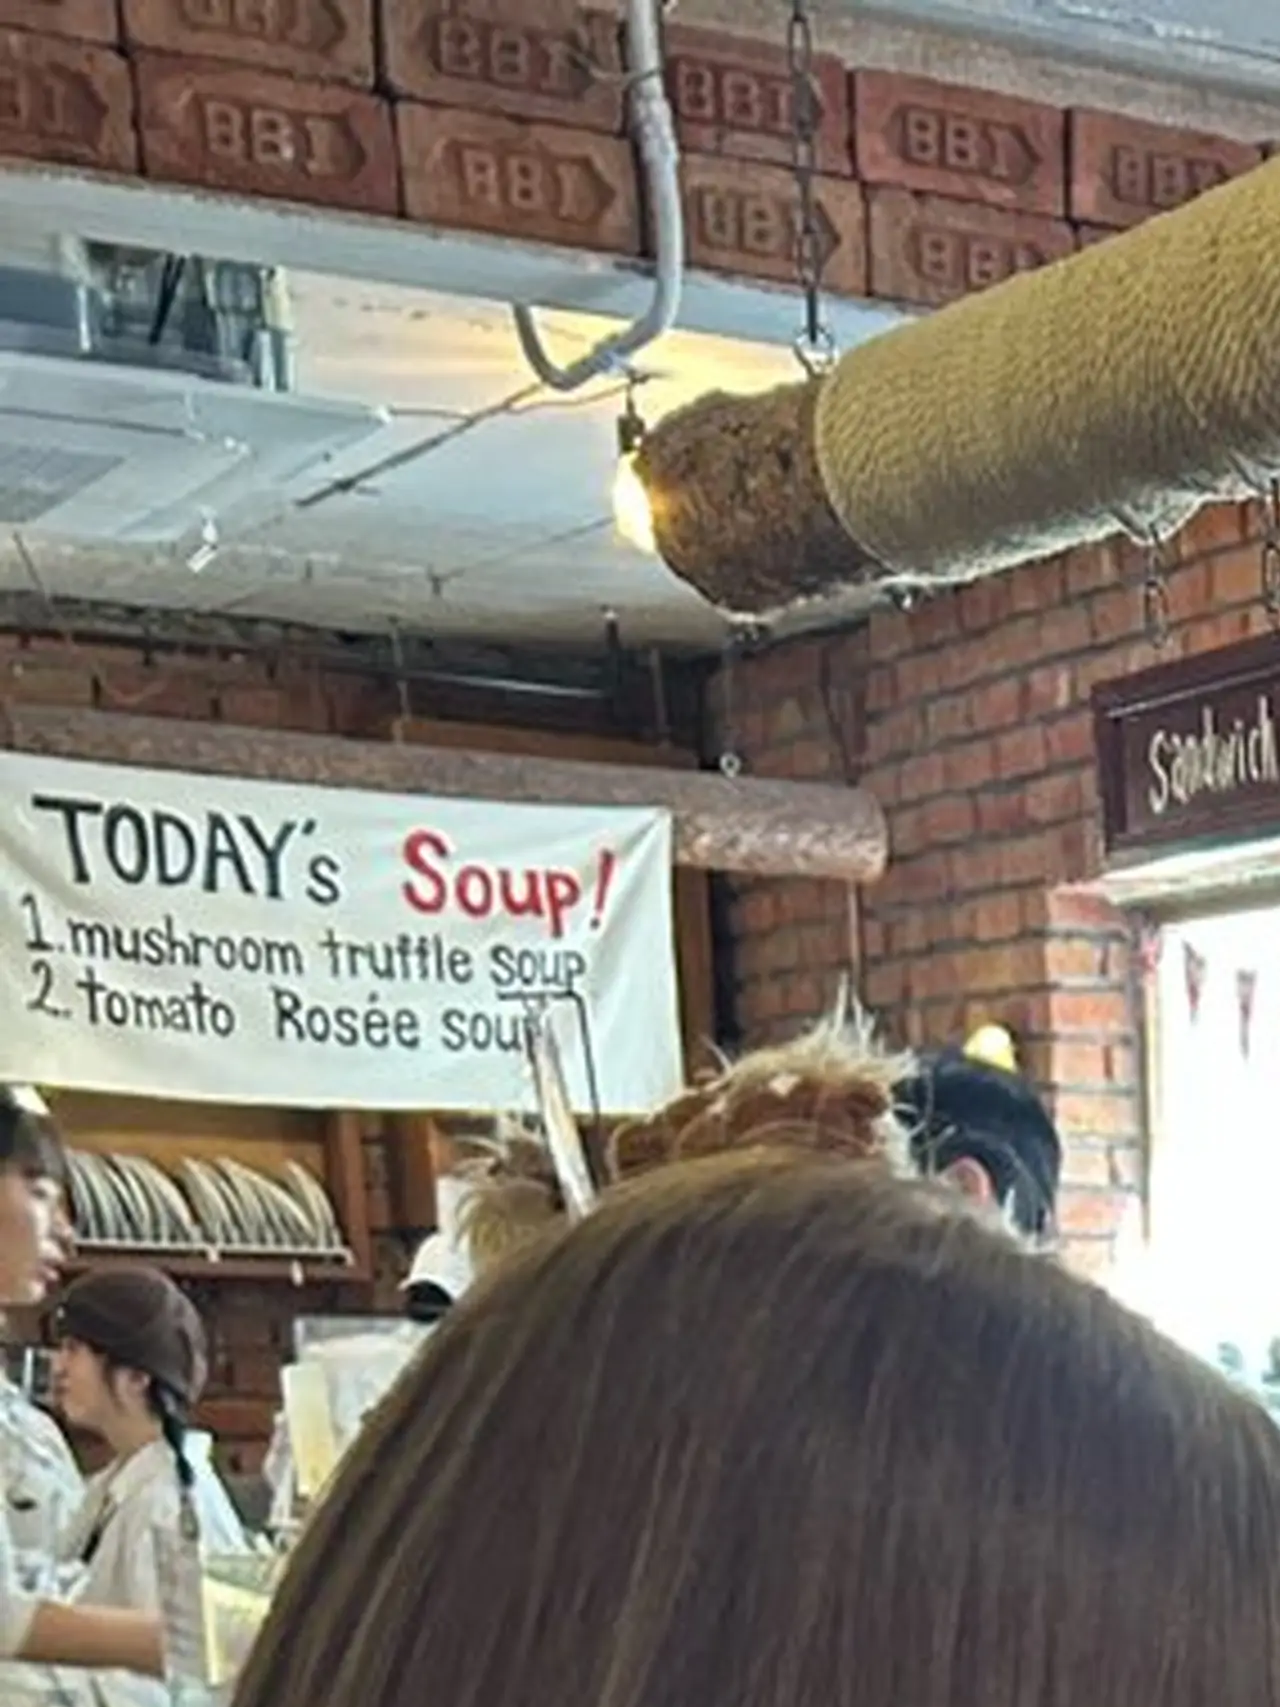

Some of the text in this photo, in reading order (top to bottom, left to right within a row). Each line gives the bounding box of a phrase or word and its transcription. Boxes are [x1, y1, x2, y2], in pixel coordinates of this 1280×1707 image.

[33, 794, 616, 937] TODAY's Soup!
[323, 930, 473, 986] truffle
[490, 944, 587, 994] soup
